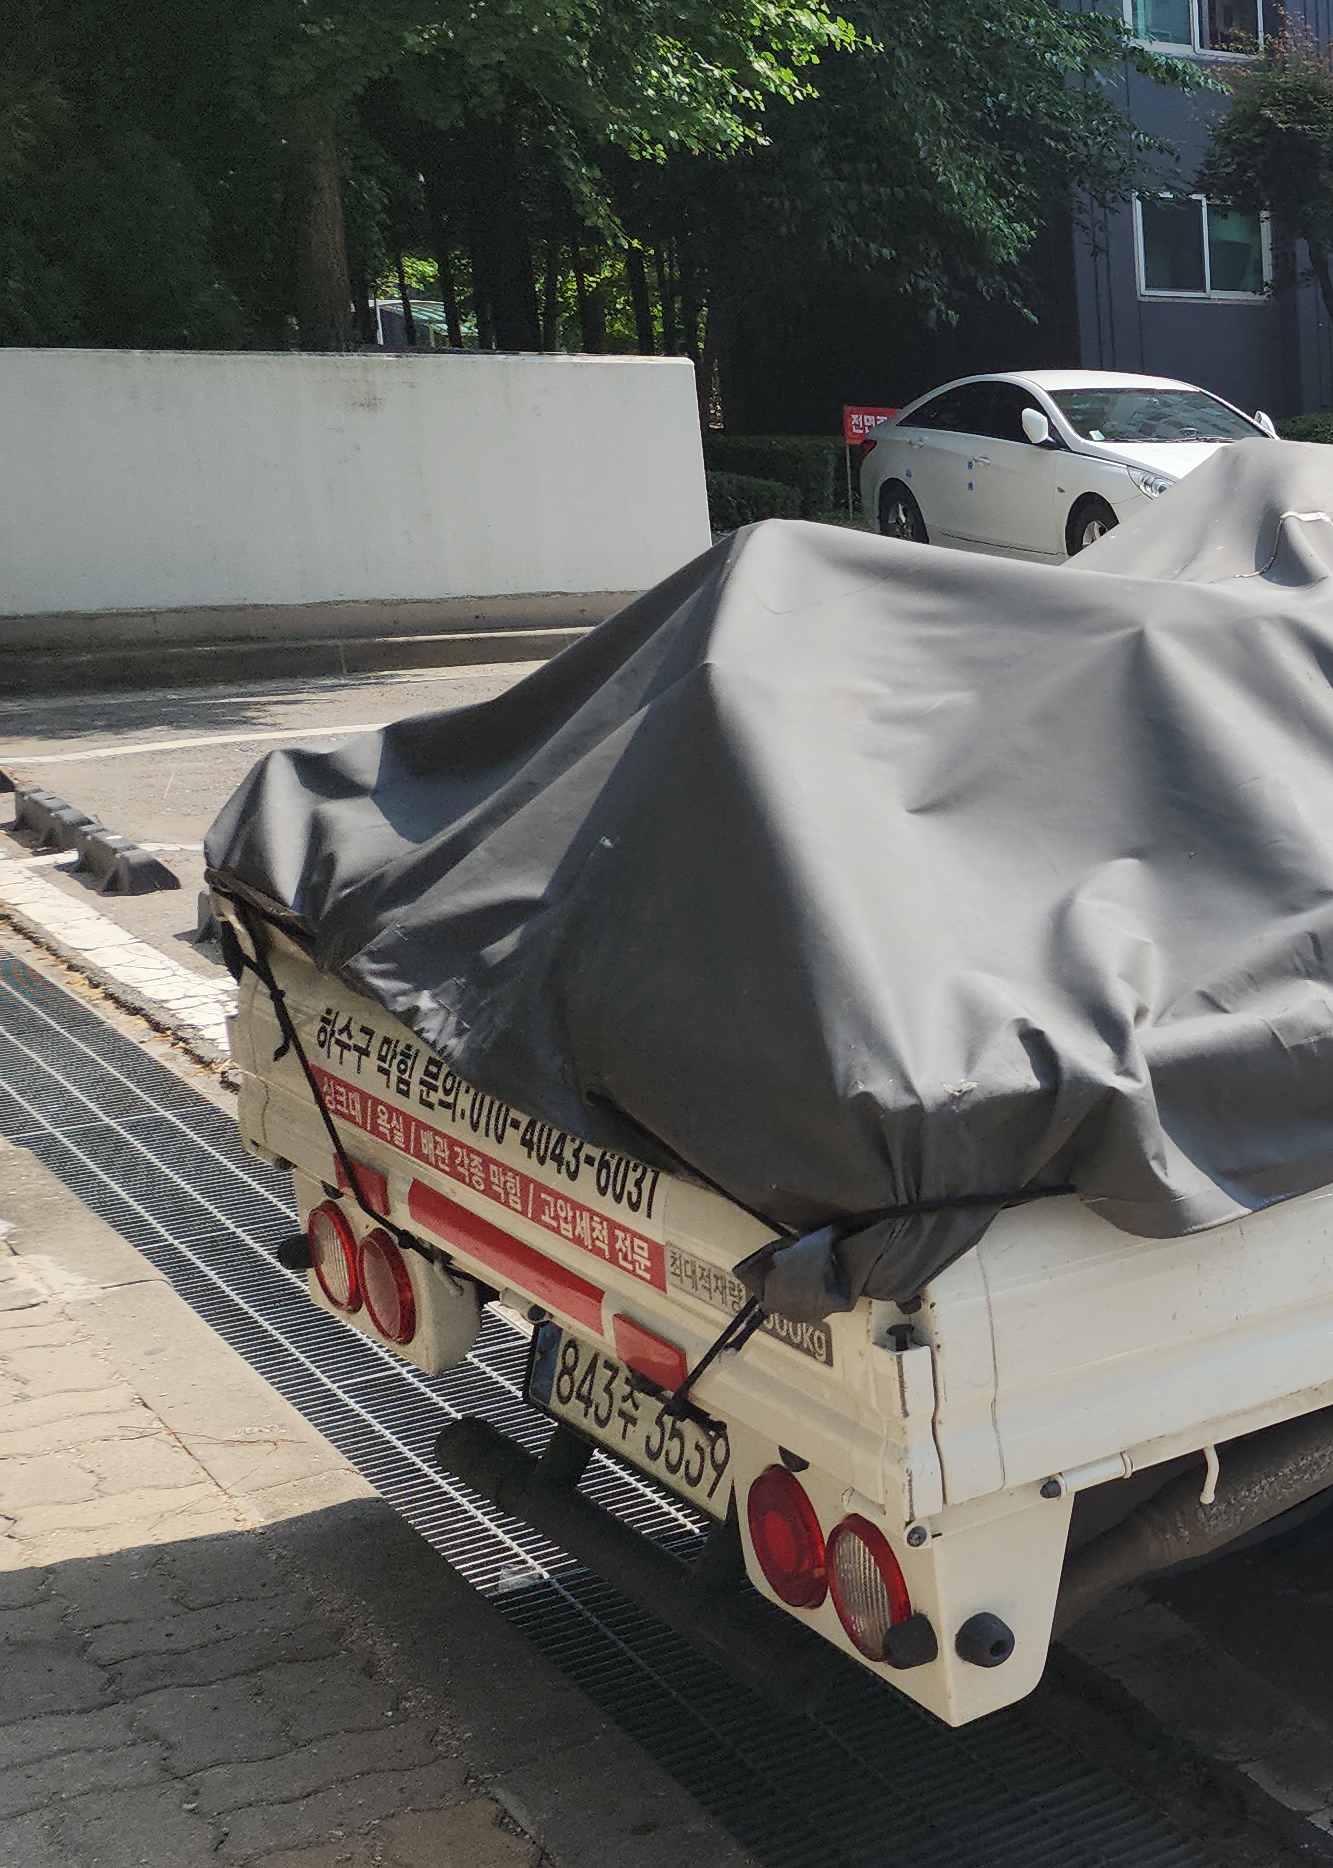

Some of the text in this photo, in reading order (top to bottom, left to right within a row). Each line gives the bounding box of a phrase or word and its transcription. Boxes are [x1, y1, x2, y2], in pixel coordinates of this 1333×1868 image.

[317, 1008, 375, 1074] 하수구
[377, 1036, 419, 1099] 막힘
[323, 1076, 361, 1126] 싱크대
[377, 1105, 405, 1148] 욕실
[420, 1129, 450, 1172] 배관
[454, 1146, 485, 1191] 각종
[489, 1164, 521, 1212] 막힘
[540, 1193, 609, 1259] 고압세척
[614, 1229, 651, 1280] 전문
[670, 1251, 743, 1311] 최대적재량
[556, 1338, 639, 1441] 843주
